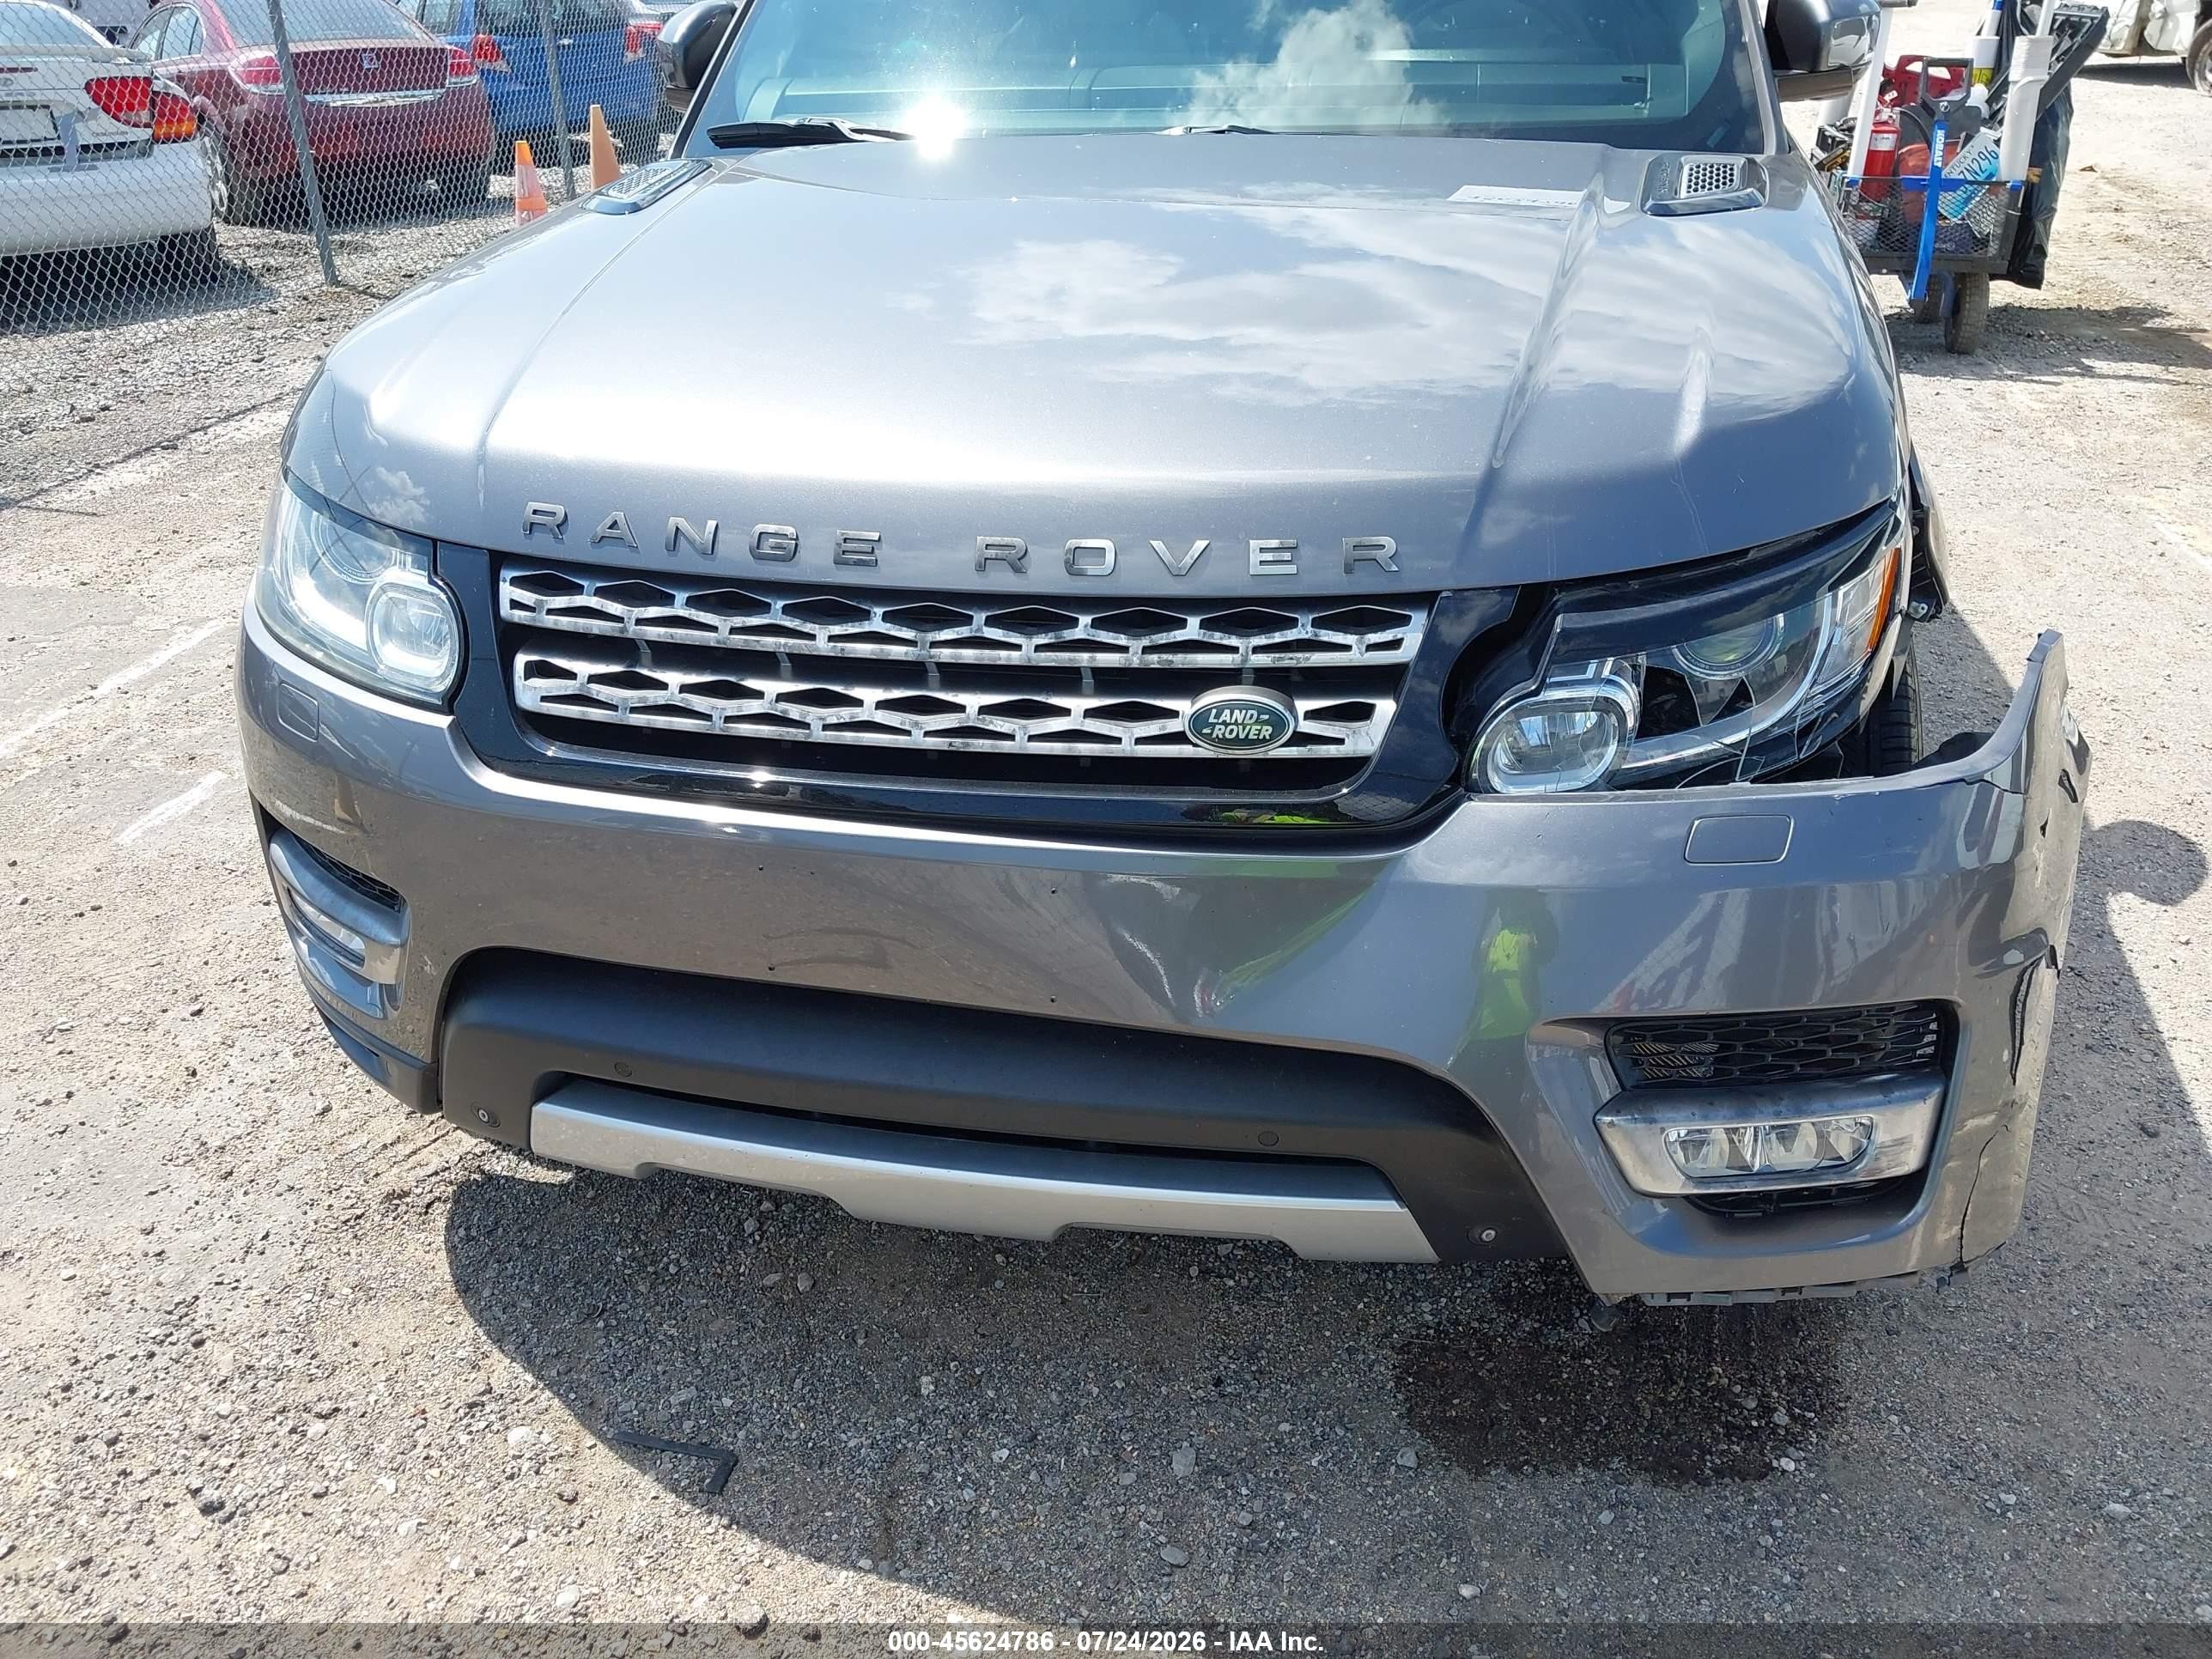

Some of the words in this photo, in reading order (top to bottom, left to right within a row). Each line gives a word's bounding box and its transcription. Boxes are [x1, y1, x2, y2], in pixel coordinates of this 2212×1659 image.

[1934, 130, 1945, 167] KOBALT
[1944, 149, 1972, 178] ENTUCKY
[522, 501, 881, 568] RANGE
[974, 536, 1400, 575] ROVER
[1208, 708, 1258, 724] LAND
[1212, 725, 1273, 740] ROVER
